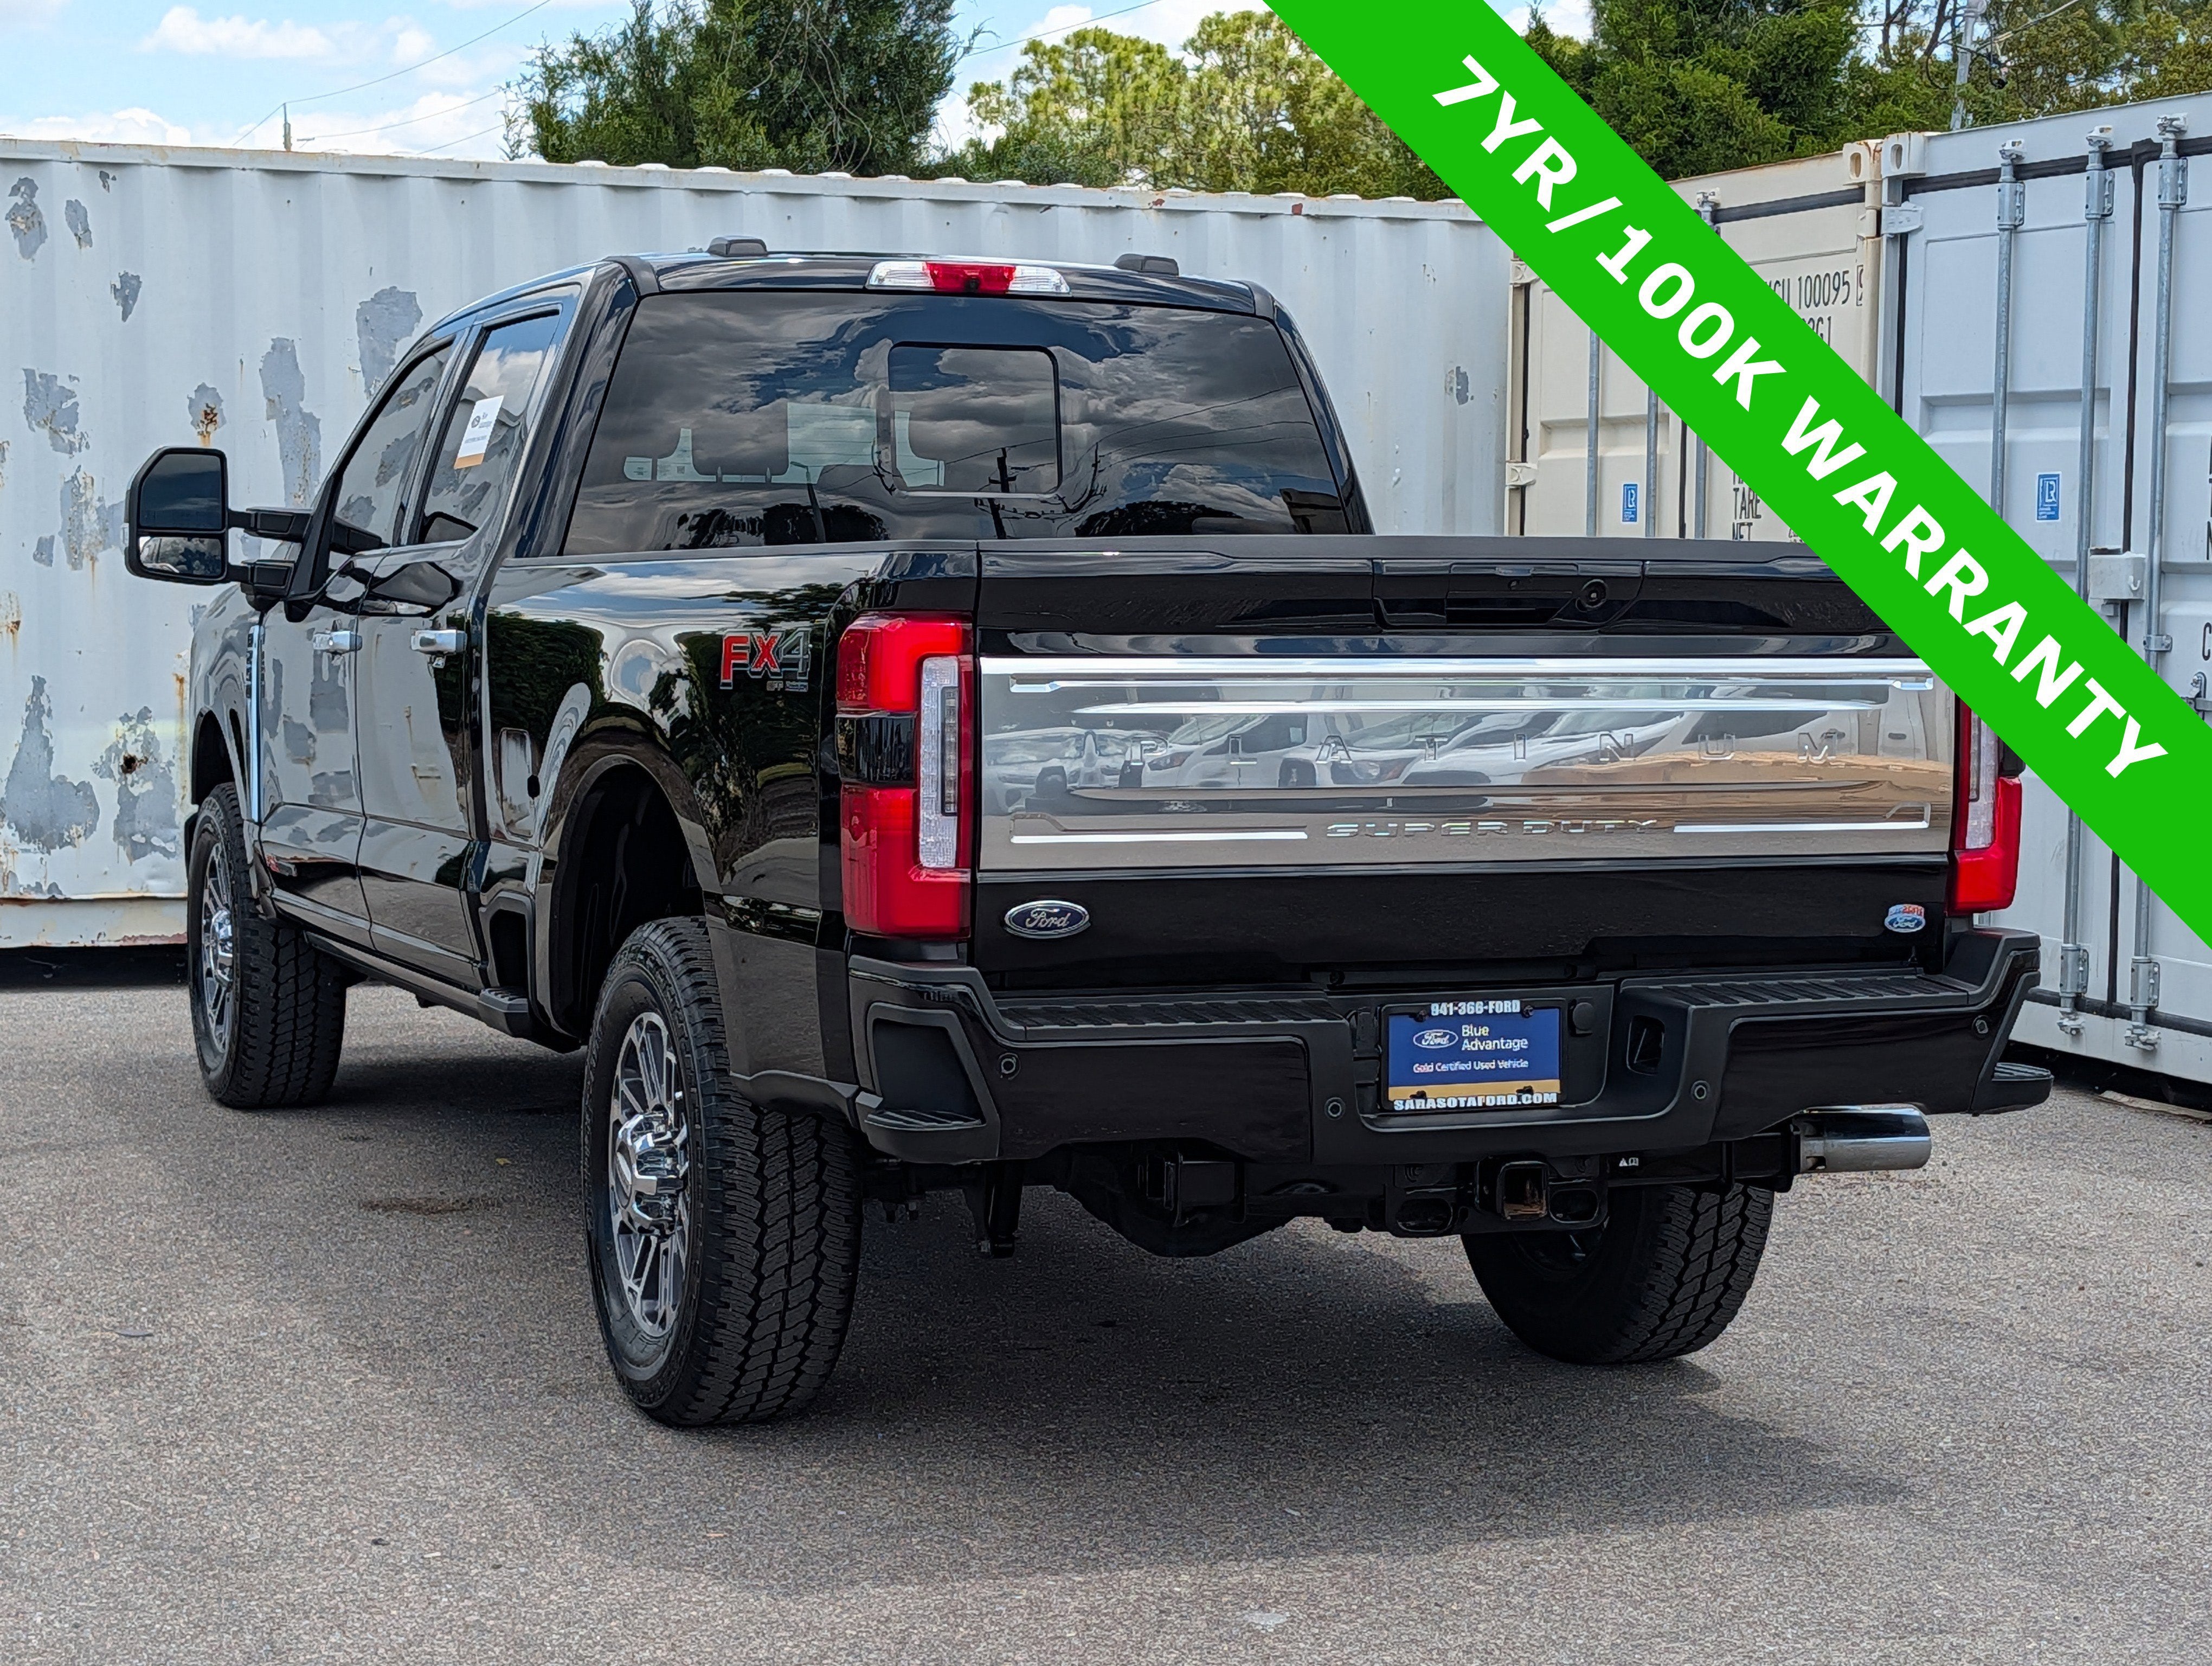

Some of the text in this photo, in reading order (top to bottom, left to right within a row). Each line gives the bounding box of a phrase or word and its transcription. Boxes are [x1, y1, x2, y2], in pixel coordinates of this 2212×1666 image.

[1798, 270, 1850, 310] 100095
[1733, 486, 1762, 520] TARE
[720, 628, 812, 690] FX4
[1128, 731, 1838, 765] PLATINUM
[1326, 819, 1658, 837] SUPER DUTY
[1462, 1023, 1490, 1037] Blue
[1462, 1037, 1529, 1052] Advantage
[1473, 1060, 1496, 1070] Used
[1497, 1058, 1529, 1069] Vehicle
[1393, 1092, 1557, 1111] SARASOTAFORD.COM
